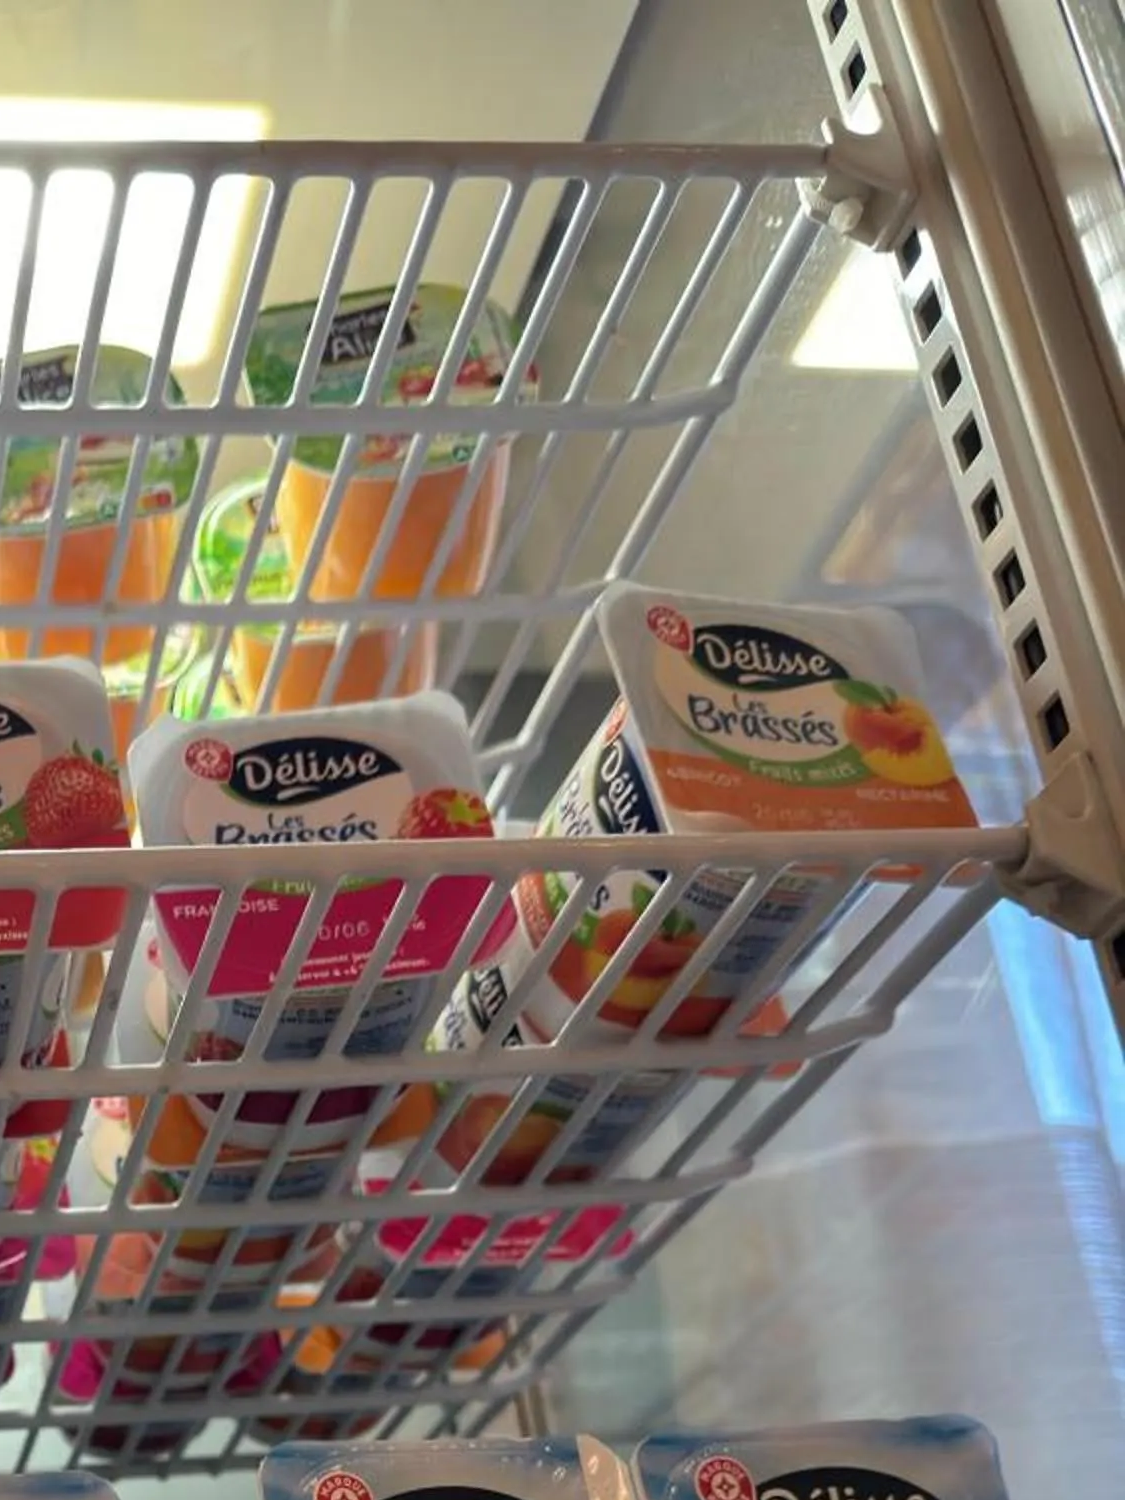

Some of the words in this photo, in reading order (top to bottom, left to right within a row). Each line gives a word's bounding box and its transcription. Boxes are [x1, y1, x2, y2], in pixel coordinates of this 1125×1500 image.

[696, 632, 831, 676] Délisse
[687, 694, 839, 747] Brassés
[732, 693, 769, 714] Les
[237, 750, 380, 792] Délisse
[268, 812, 304, 829] Les
